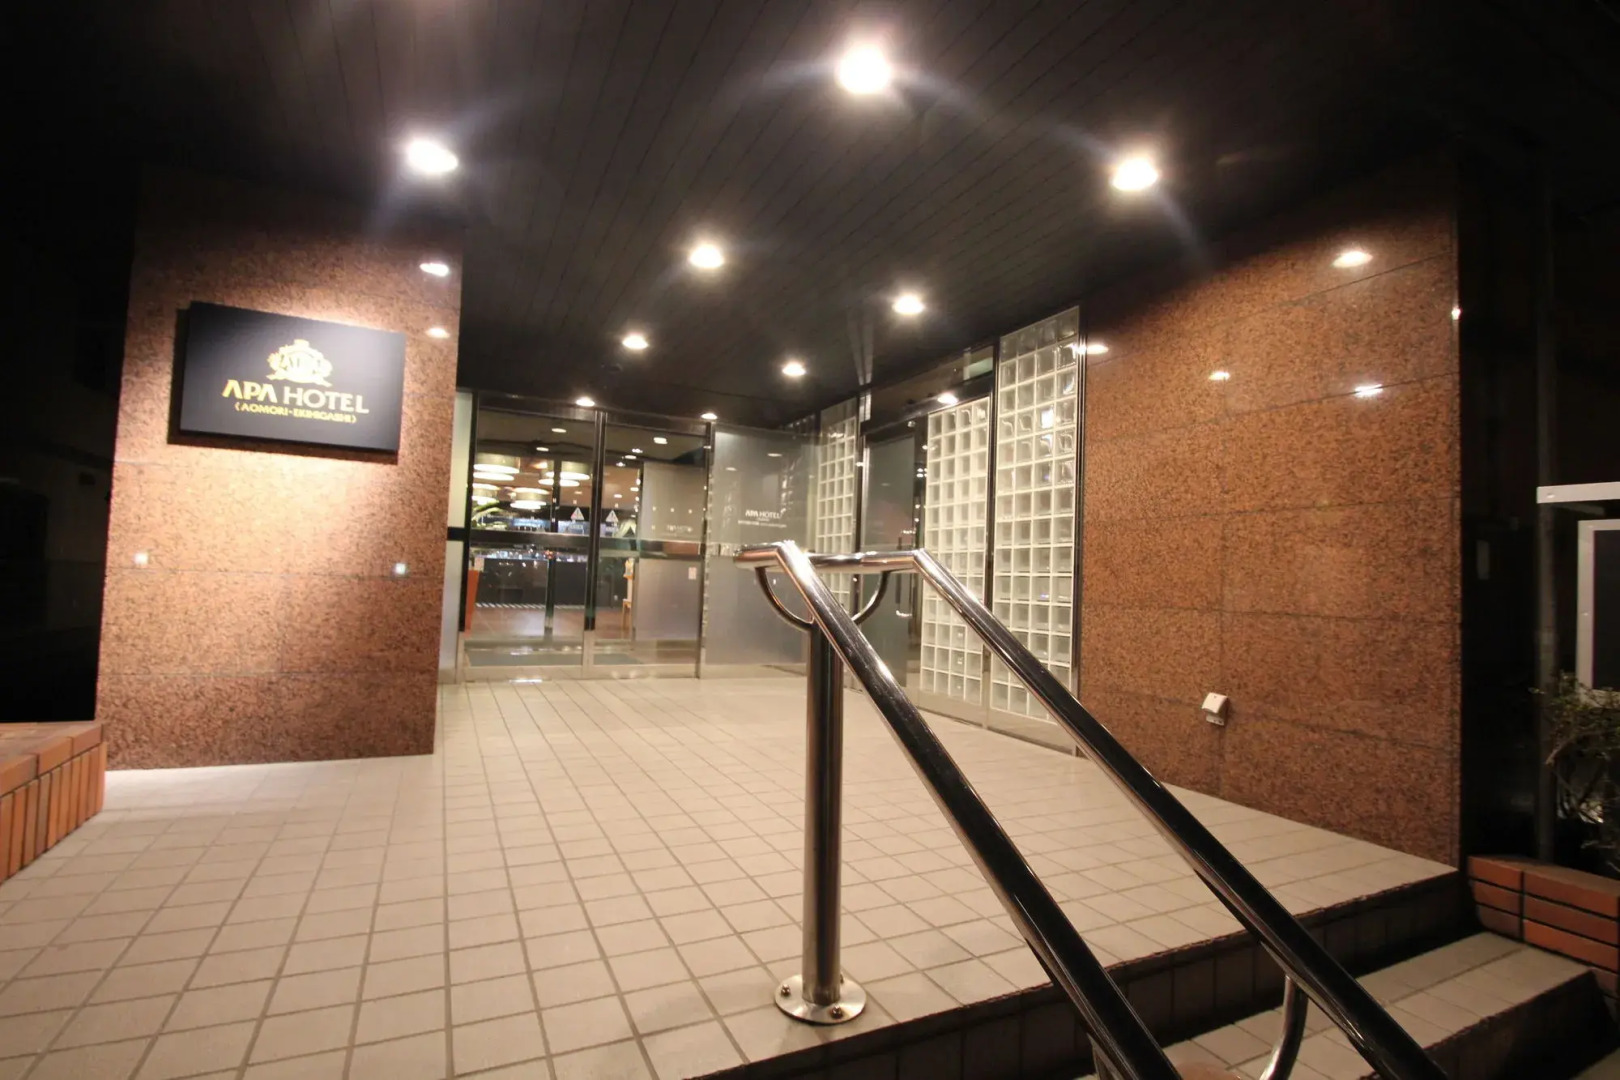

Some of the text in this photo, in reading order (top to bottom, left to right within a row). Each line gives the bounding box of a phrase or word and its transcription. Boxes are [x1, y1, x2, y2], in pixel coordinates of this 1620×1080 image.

[222, 379, 370, 414] APA HOTEL
[745, 509, 759, 518] APA
[759, 511, 781, 520] HOTEL
